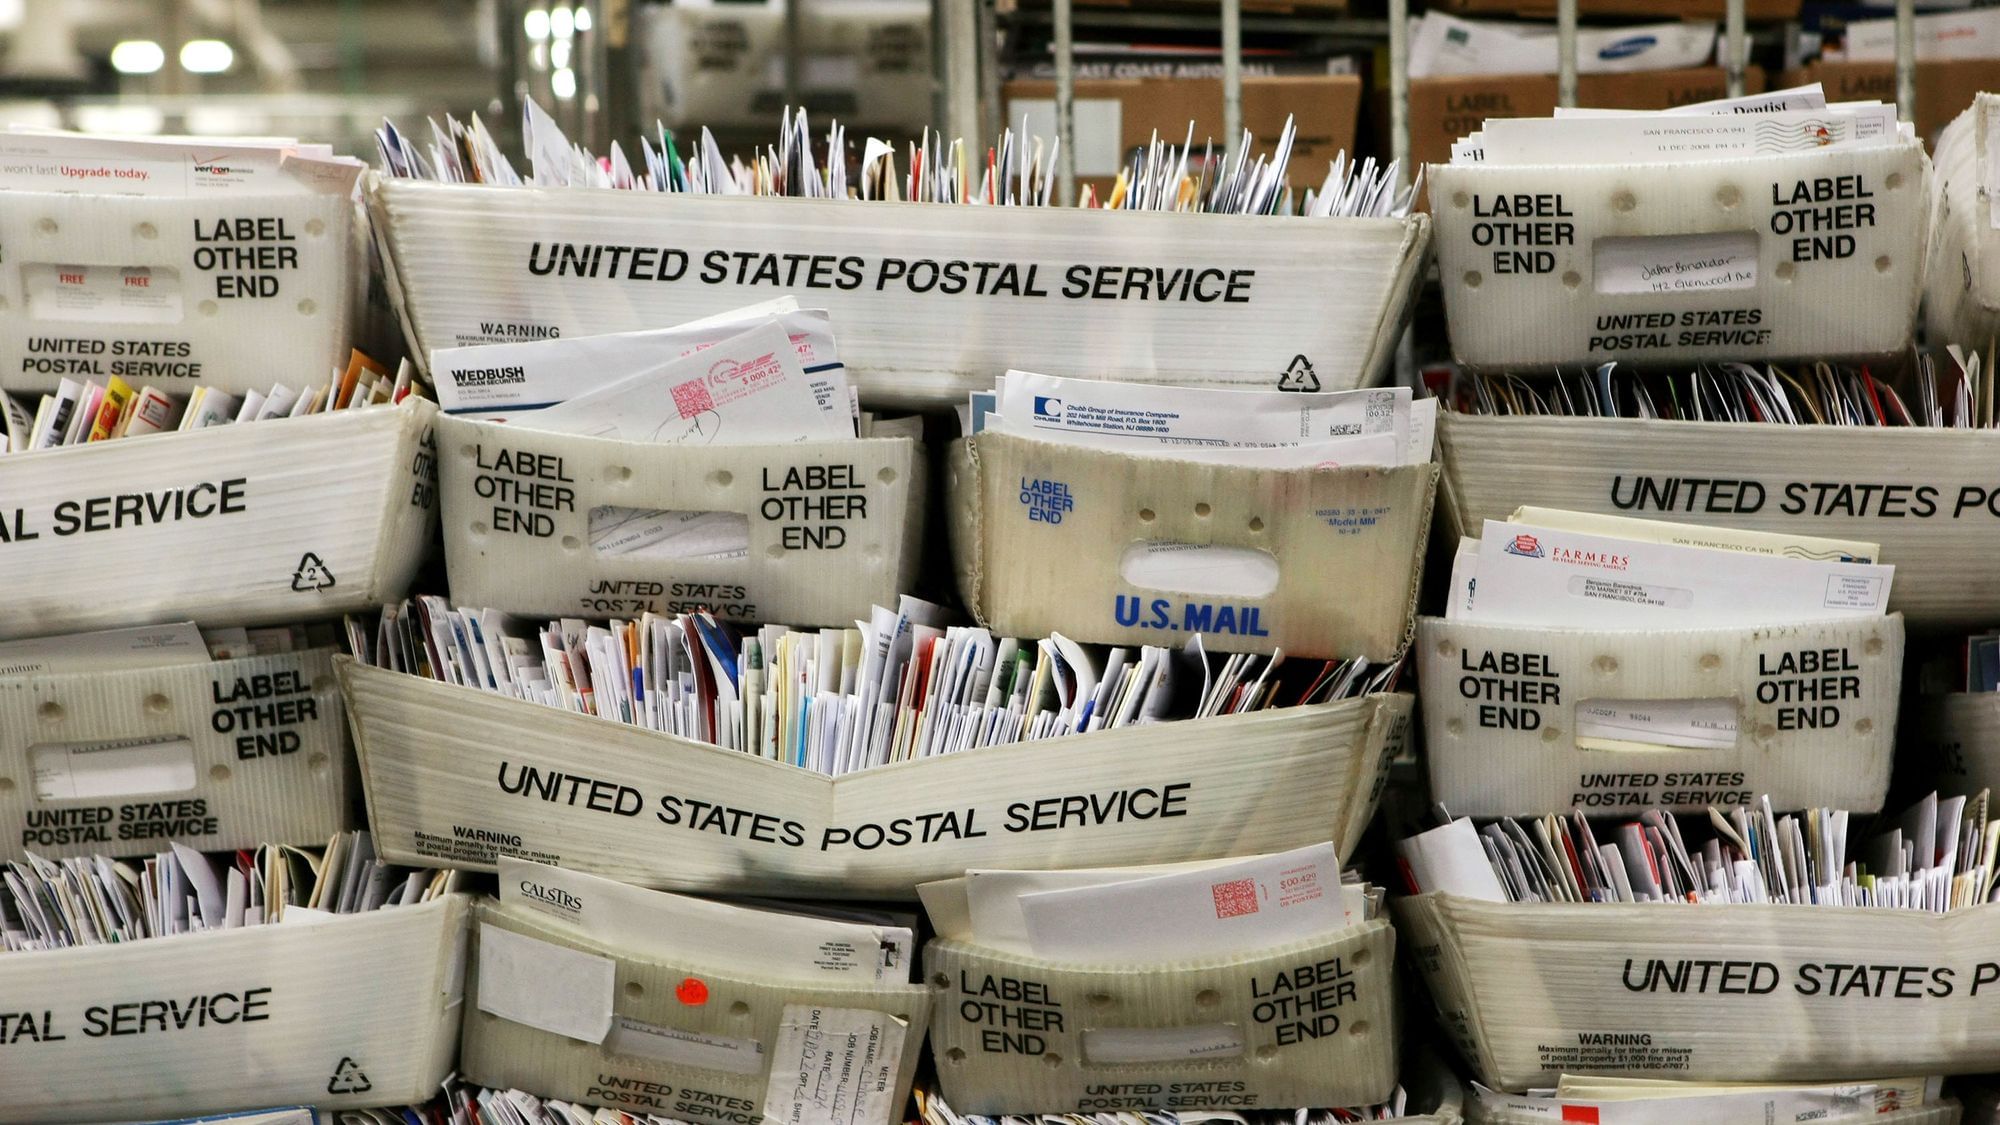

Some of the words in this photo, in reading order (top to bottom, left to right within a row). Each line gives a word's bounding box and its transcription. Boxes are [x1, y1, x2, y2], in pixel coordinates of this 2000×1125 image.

[1664, 127, 1713, 136] FRANCISCO
[61, 166, 111, 179] Upgrade
[115, 168, 150, 180] today.
[1772, 174, 1874, 206] LABEL
[1473, 194, 1573, 218] LABEL
[194, 218, 295, 241] LABEL
[1771, 204, 1875, 235] OTHER
[1471, 222, 1575, 246] OTHER
[194, 247, 297, 270] OTHER
[1792, 235, 1856, 263] END
[527, 242, 690, 283] UNITED
[700, 250, 866, 290] STATES
[875, 258, 1048, 297] POSTAL
[1061, 264, 1255, 304] SERVICE
[1494, 251, 1555, 274] END
[60, 273, 85, 284] FREE
[125, 277, 149, 287] FREE
[216, 276, 279, 298] END
[480, 322, 561, 339] WARNING
[1596, 313, 1676, 331] UNITED
[1680, 309, 1763, 327] STATES
[28, 338, 105, 354] UNITED
[112, 341, 191, 357] STATES
[1589, 333, 1671, 352] POSTAL
[1677, 330, 1772, 348] SERVICE
[22, 358, 104, 374] POSTAL
[111, 360, 201, 378] SERVICE
[452, 366, 525, 382] WEDBUSH
[1295, 370, 1304, 384] 2
[486, 377, 526, 386] SECURITIES
[1066, 420, 1102, 428] Whitehouse
[1102, 422, 1124, 430] Station,
[1115, 409, 1145, 417] Insurance
[1146, 411, 1180, 420] Companies
[476, 444, 574, 483] LABEL
[762, 464, 866, 491] LABEL
[1022, 476, 1073, 498] LABEL
[474, 474, 575, 512] OTHER
[1020, 491, 1073, 512] OTHER
[1611, 476, 1766, 514] UNITED
[1780, 483, 1940, 518] STATES
[53, 477, 247, 536] SERVICE
[761, 495, 867, 520] OTHER
[1029, 507, 1062, 524] END
[493, 507, 555, 538] END
[782, 525, 846, 550] END
[1672, 538, 1690, 546] SAN
[1693, 540, 1742, 551] FRANCISCO
[1553, 547, 1629, 567] FARMERS
[589, 580, 664, 596] UNITED
[671, 583, 746, 600] STATES
[1115, 595, 1178, 632] U.S.
[1185, 604, 1269, 637] MAIL
[1461, 648, 1560, 678] LABEL
[1759, 648, 1859, 676] LABEL
[212, 670, 311, 704] LABEL
[1459, 676, 1561, 706] OTHER
[1757, 675, 1861, 704] OTHER
[211, 698, 318, 733] OTHER
[1479, 705, 1541, 732] END
[1777, 705, 1841, 731] END
[236, 731, 301, 760] END
[1580, 773, 1658, 788] UNITED
[1664, 772, 1745, 787] STATES
[498, 761, 642, 817] UNITED
[656, 796, 805, 847] STATES
[821, 808, 987, 851] POSTAL
[1004, 783, 1191, 832] SERVICE
[1572, 792, 1654, 807] POSTAL
[1660, 791, 1752, 805] SERVICE
[26, 805, 113, 828] UNITED
[120, 799, 207, 822] STATES
[22, 825, 111, 847] POSTAL
[118, 818, 218, 840] SERVICE
[453, 825, 522, 847] WARNING
[414, 831, 452, 844] Maximum
[454, 838, 484, 851] penalty
[486, 843, 498, 851] for
[500, 846, 518, 855] theft
[531, 851, 561, 861] misuse
[426, 842, 452, 852] postal
[454, 848, 488, 859] property
[520, 880, 582, 909] CALSTRS
[960, 970, 1062, 1008] LABEL
[1250, 957, 1353, 998] LABEL
[1622, 959, 1779, 995] UNITED
[1794, 964, 1954, 999] STATES
[82, 987, 272, 1038] SERVICE
[1252, 982, 1357, 1023] OTHER
[810, 1009, 820, 1030] DATE
[960, 1000, 1064, 1032] OTHER
[848, 1032, 856, 1049] JOB
[1275, 1014, 1340, 1046] END
[1578, 1033, 1652, 1046] WARNING
[982, 1031, 1046, 1056] END
[1538, 1045, 1578, 1054] Maximum
[1581, 1047, 1612, 1055] penalty
[1628, 1046, 1648, 1054] theft
[822, 1050, 834, 1072] RATE
[1552, 1054, 1578, 1062] postal
[1580, 1055, 1616, 1063] property
[876, 1066, 888, 1092] METER
[1086, 1083, 1162, 1095] UNITED
[1169, 1081, 1245, 1094] STATES
[598, 1074, 673, 1097] UNITED
[679, 1087, 754, 1112] STATES
[1078, 1096, 1159, 1109] POSTAL
[1167, 1094, 1257, 1107] SERVICE
[587, 1086, 667, 1110] POSTAL
[674, 1100, 766, 1125] SERVICE
[792, 1102, 802, 1123] SHIFT
